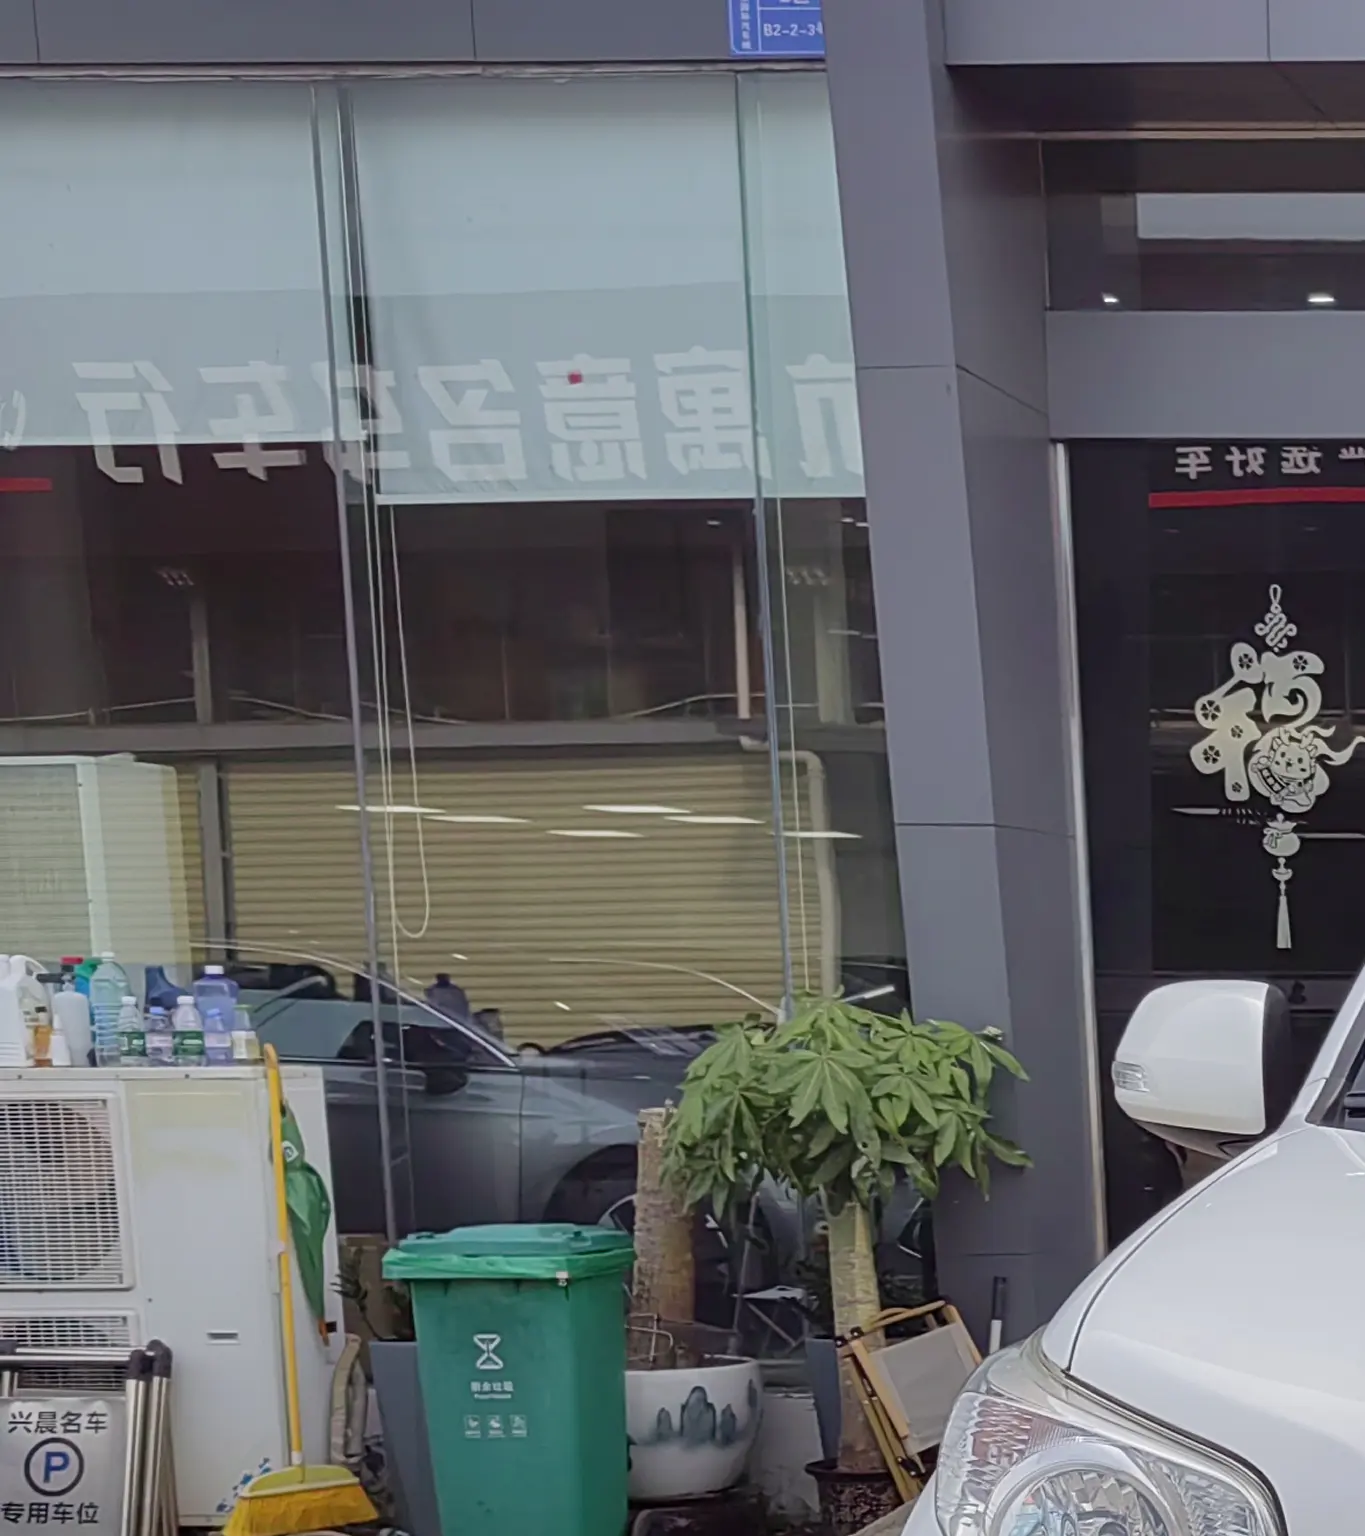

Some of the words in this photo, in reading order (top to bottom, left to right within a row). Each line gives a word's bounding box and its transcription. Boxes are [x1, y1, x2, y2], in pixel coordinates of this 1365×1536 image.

[8, 1411, 108, 1434] 兴晨名车
[43, 1451, 70, 1483] P
[1, 1501, 100, 1525] 专用车位
